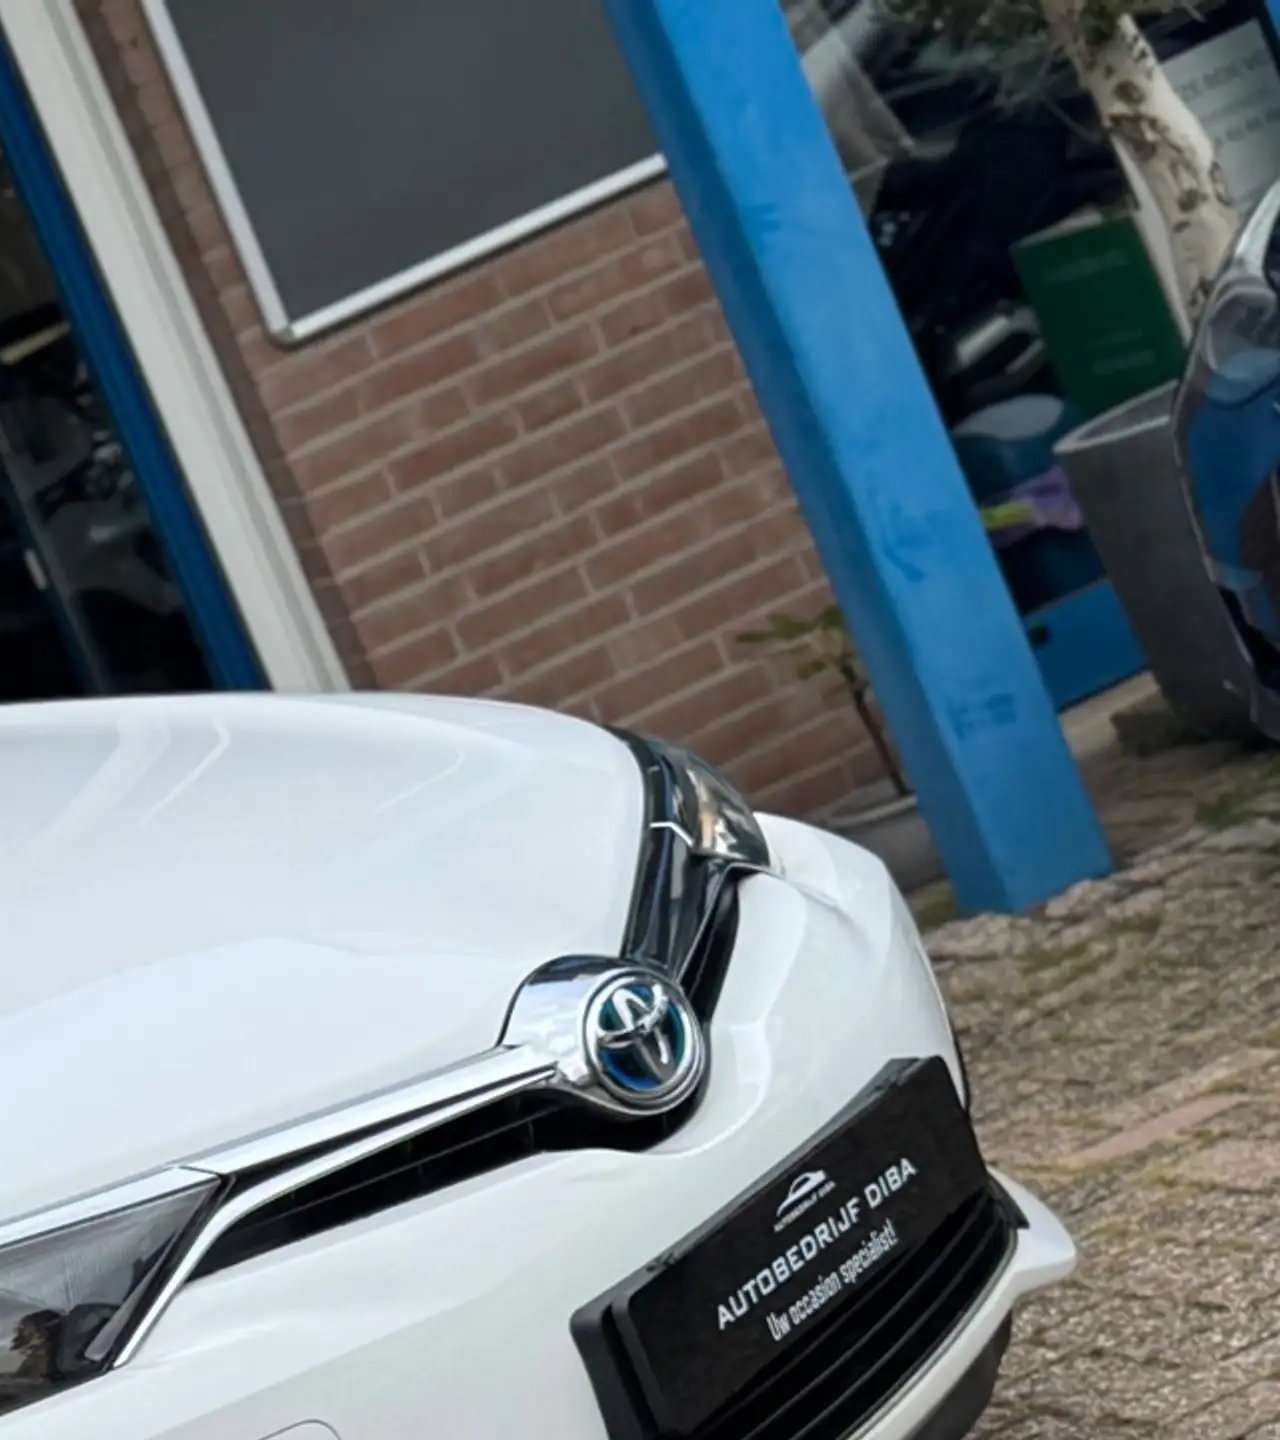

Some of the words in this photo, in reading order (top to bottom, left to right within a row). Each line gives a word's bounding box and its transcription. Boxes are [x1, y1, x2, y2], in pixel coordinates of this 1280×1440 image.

[717, 1197, 861, 1331] AUTOBEDRIJF
[863, 1157, 918, 1210] DIBA
[765, 1311, 791, 1341] Uw
[788, 1271, 842, 1325] occasion
[839, 1217, 900, 1283] specialist!
